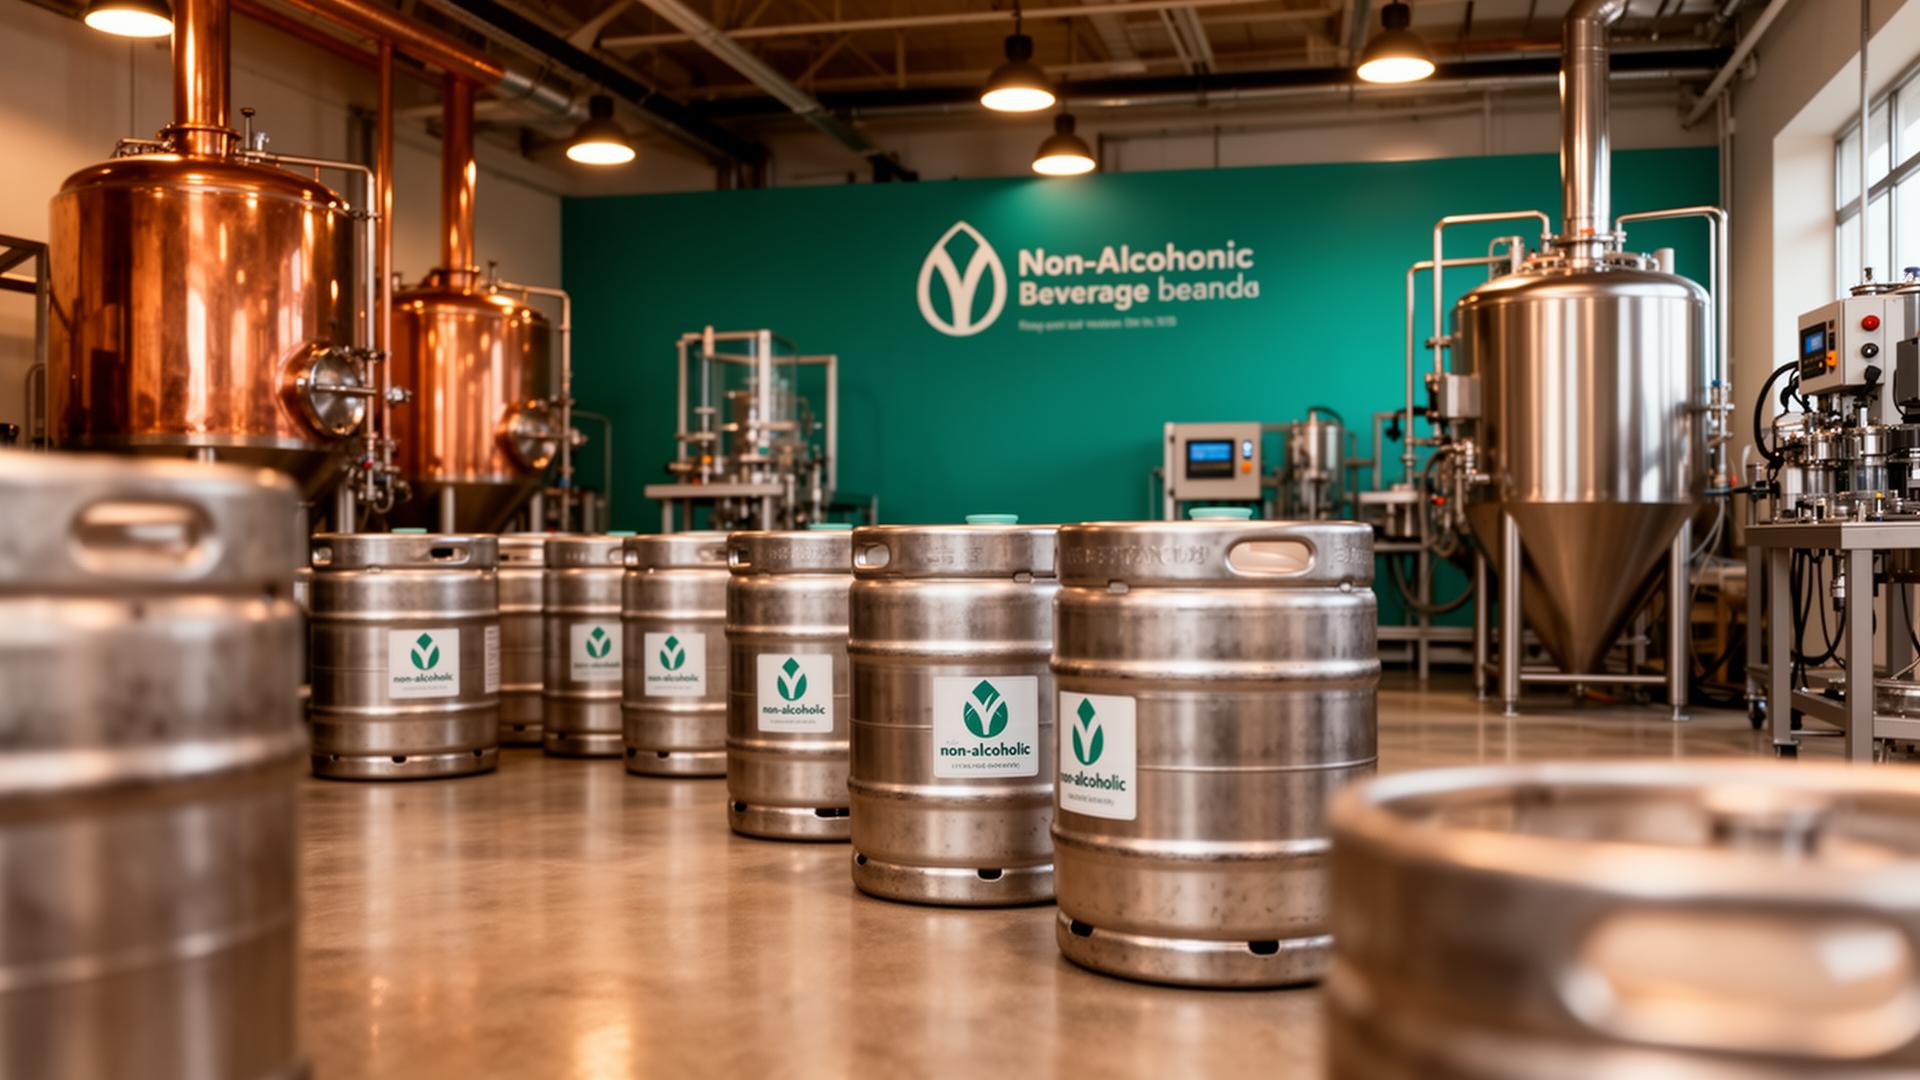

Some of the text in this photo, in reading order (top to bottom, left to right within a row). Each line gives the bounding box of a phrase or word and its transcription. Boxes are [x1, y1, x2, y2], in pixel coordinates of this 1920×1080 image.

[1018, 240, 1254, 276] Non-Alcohonic
[1018, 281, 1150, 311] Beverage
[940, 742, 1031, 756] non-alcoholic
